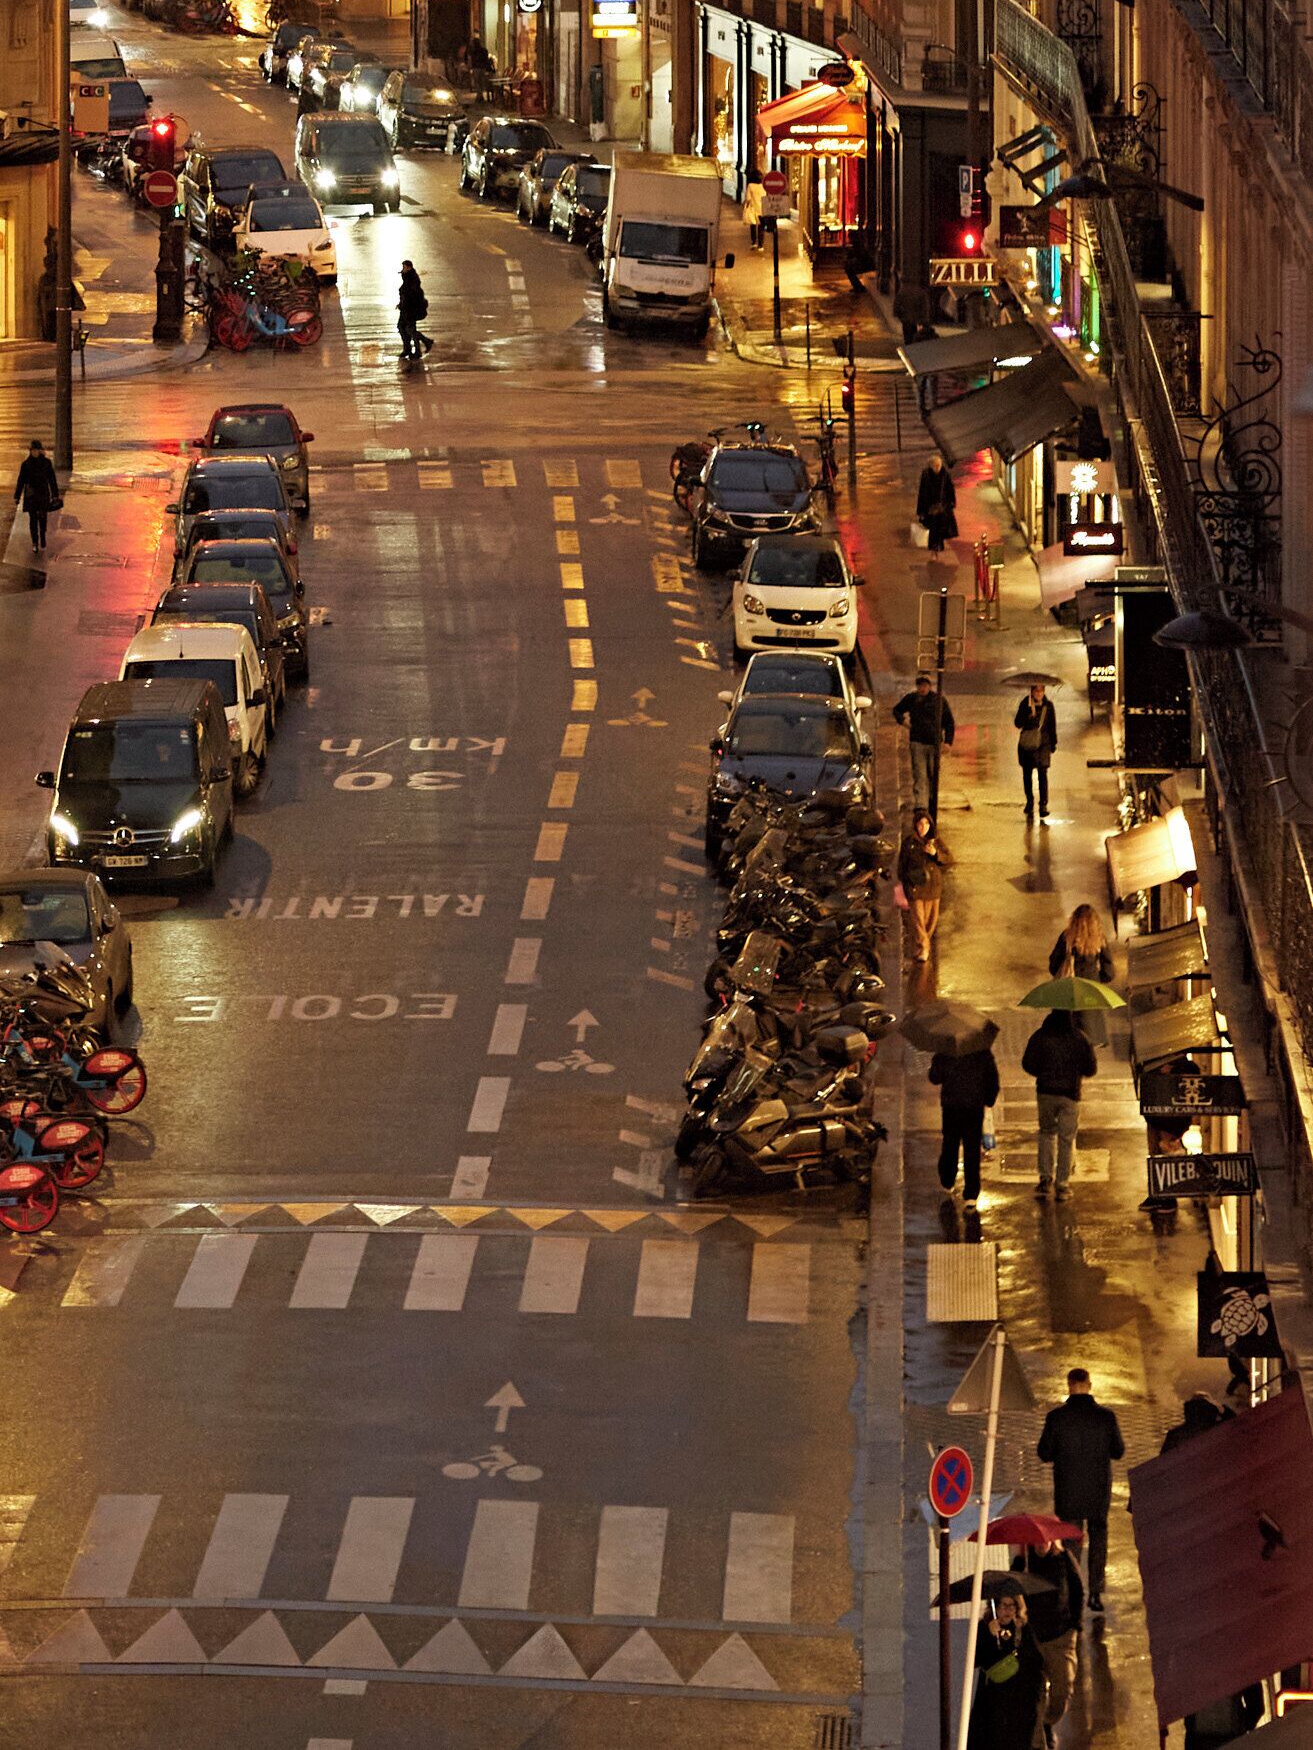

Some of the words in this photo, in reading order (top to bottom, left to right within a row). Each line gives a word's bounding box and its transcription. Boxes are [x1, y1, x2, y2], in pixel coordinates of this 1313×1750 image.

[935, 262, 994, 283] ZILLI
[1128, 706, 1187, 715] Kiton
[334, 771, 466, 791] 30
[224, 894, 486, 920] RALENTIR
[173, 993, 459, 1022] ECOLE
[1155, 1160, 1248, 1191] VILEBQUIN
